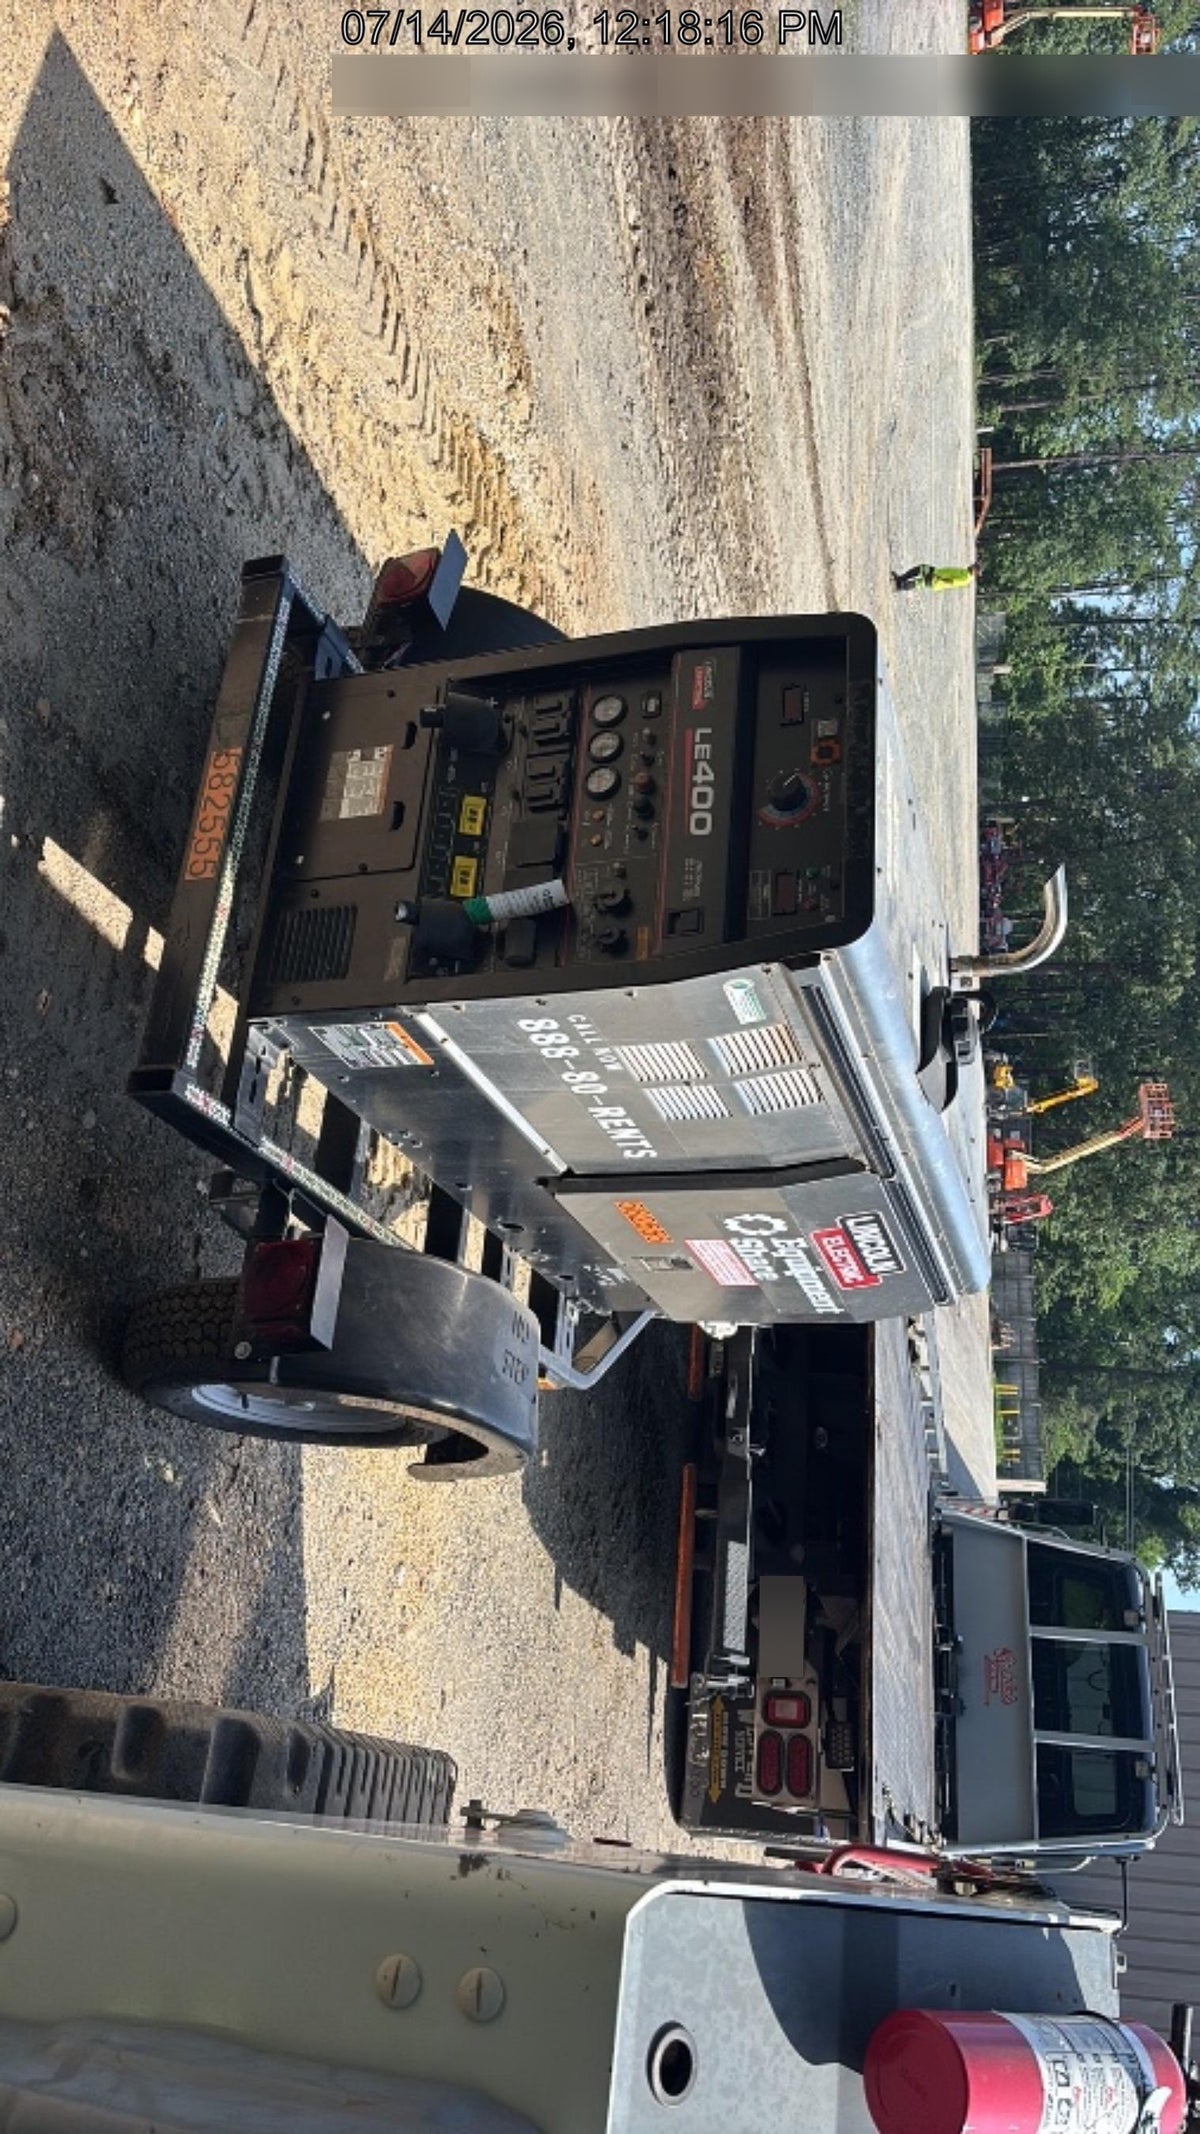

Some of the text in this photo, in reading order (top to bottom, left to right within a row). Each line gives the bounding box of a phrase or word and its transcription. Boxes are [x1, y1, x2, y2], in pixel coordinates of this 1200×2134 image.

[187, 751, 240, 878] 582555
[689, 728, 715, 835] LE400
[567, 1014, 621, 1071] CALL NOW
[518, 1018, 658, 1159] 888-80-RENTS
[729, 1237, 780, 1281] Share
[770, 1237, 845, 1314] Equipment
[822, 1236, 865, 1284] ELECTRIC
[847, 1216, 898, 1274] LINCOLN
